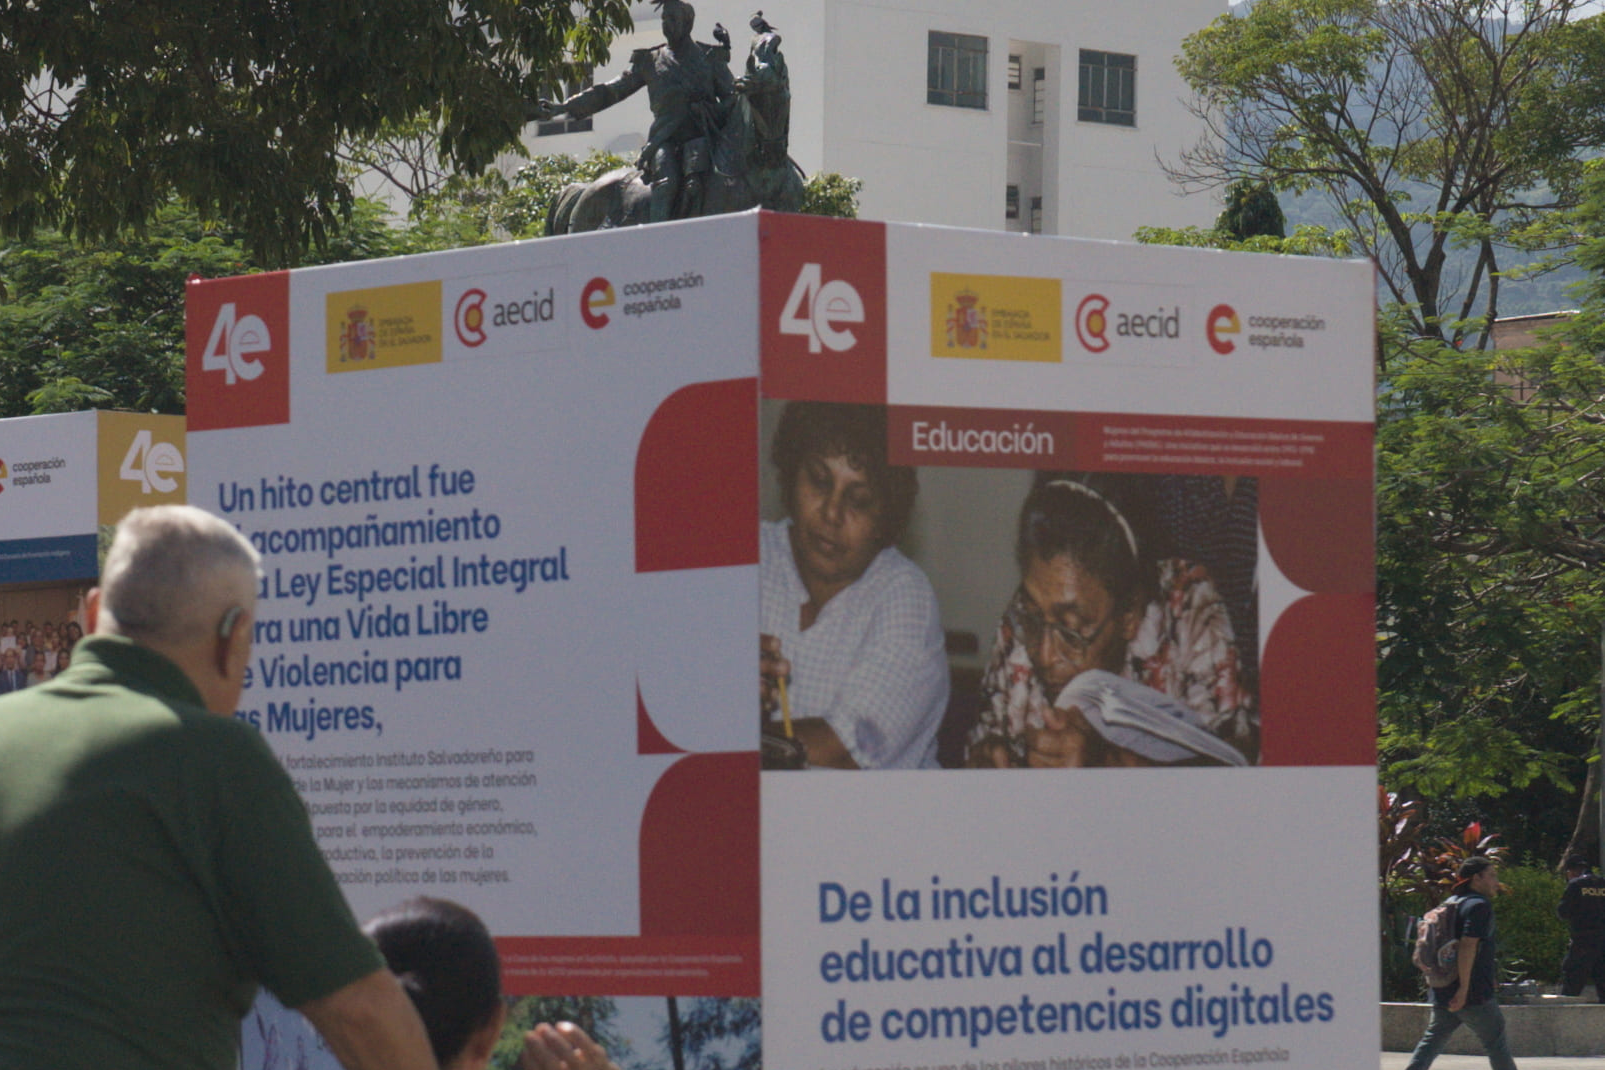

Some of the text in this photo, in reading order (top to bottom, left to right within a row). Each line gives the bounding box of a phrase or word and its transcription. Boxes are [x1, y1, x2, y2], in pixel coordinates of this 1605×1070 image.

[623, 272, 704, 297] cooperación
[494, 288, 554, 328] aecid
[623, 295, 681, 318] española
[1116, 307, 1179, 340] aecid
[1249, 313, 1325, 336] cooperación
[1249, 331, 1304, 351] española
[912, 420, 1054, 454] Educación
[12, 456, 66, 473] cooperación
[12, 472, 51, 488] española
[218, 464, 475, 513] Un hito central fue
[252, 509, 500, 558] acompañamiento
[276, 568, 320, 606] Ley
[328, 556, 445, 600] Especial
[454, 547, 569, 593] Integral
[289, 617, 340, 643] una
[347, 604, 410, 640] Vida
[417, 601, 488, 635] Libre
[259, 651, 388, 689] Violencia
[395, 654, 462, 691] para
[267, 698, 383, 740] Mujeres,
[818, 870, 1108, 924] De la inclusión
[820, 927, 1273, 983] educativa al desarrollo
[821, 982, 1335, 1048] de competencias digitales
[1049, 1054, 1112, 1070] históricos
[1115, 1054, 1131, 1069] de
[1134, 1052, 1147, 1068] la
[1149, 1049, 1229, 1069] Cooperación
[1231, 1046, 1289, 1066] Española
